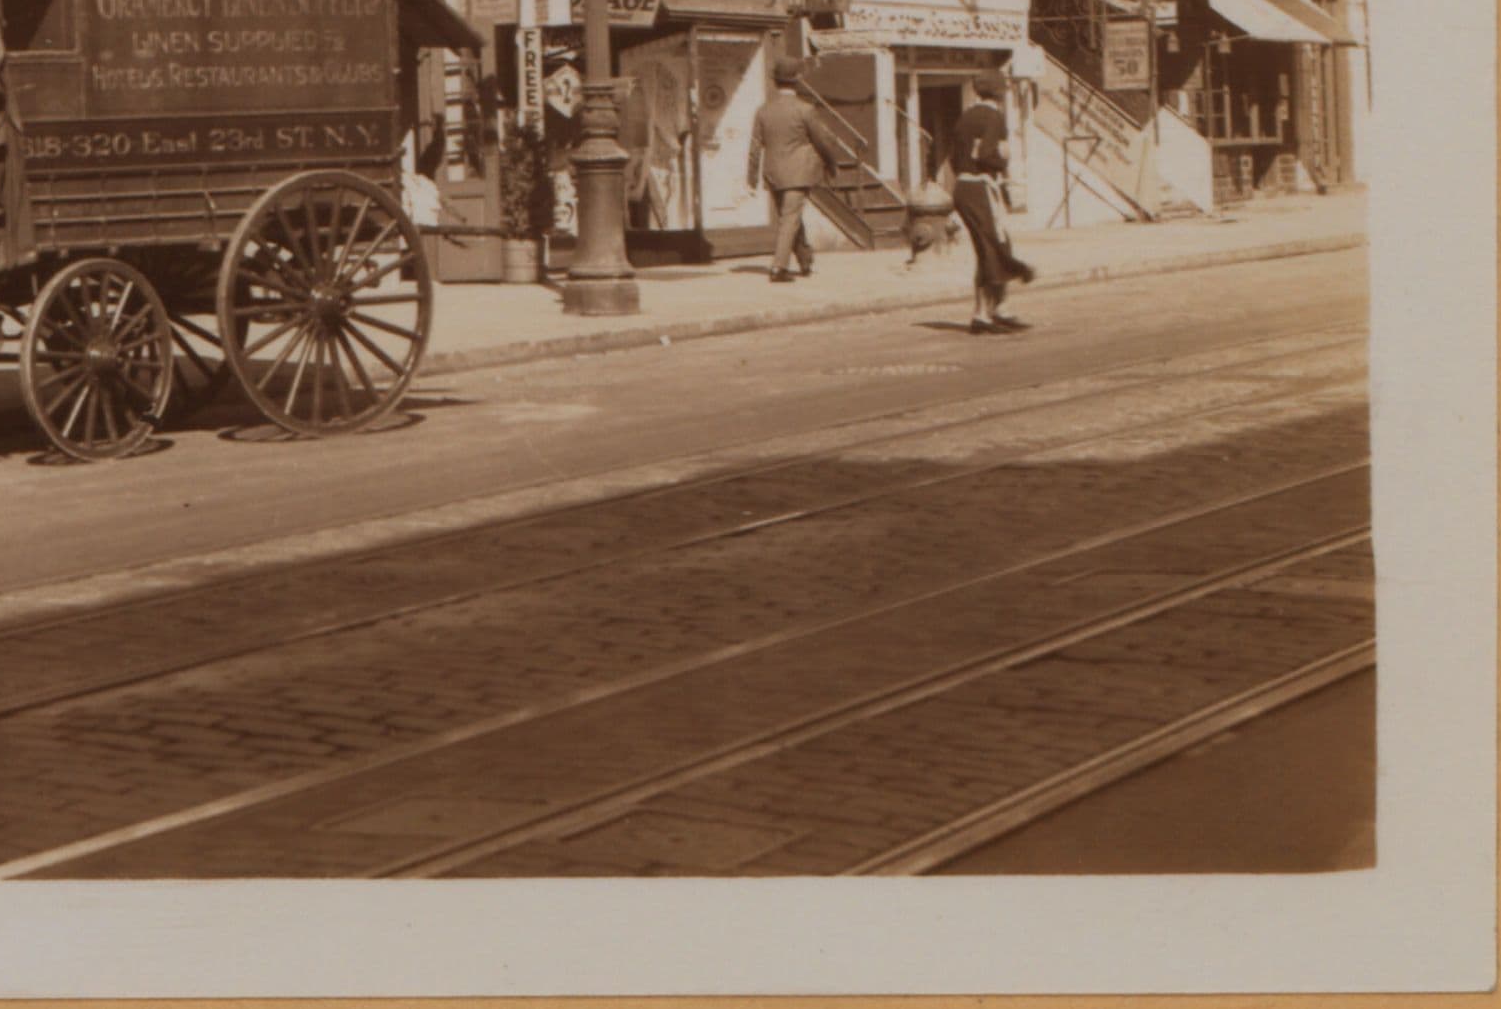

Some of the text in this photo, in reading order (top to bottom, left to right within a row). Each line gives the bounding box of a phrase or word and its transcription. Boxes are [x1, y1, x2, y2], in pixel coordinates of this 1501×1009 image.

[132, 30, 200, 54] LINEN
[207, 29, 317, 53] SUPPLIED
[92, 63, 163, 90] HOTELS
[168, 62, 307, 88] RESTAURANTS
[323, 60, 384, 85] CLUBS
[523, 30, 538, 106] FREE
[141, 132, 197, 156] East
[209, 128, 265, 152] 23rd
